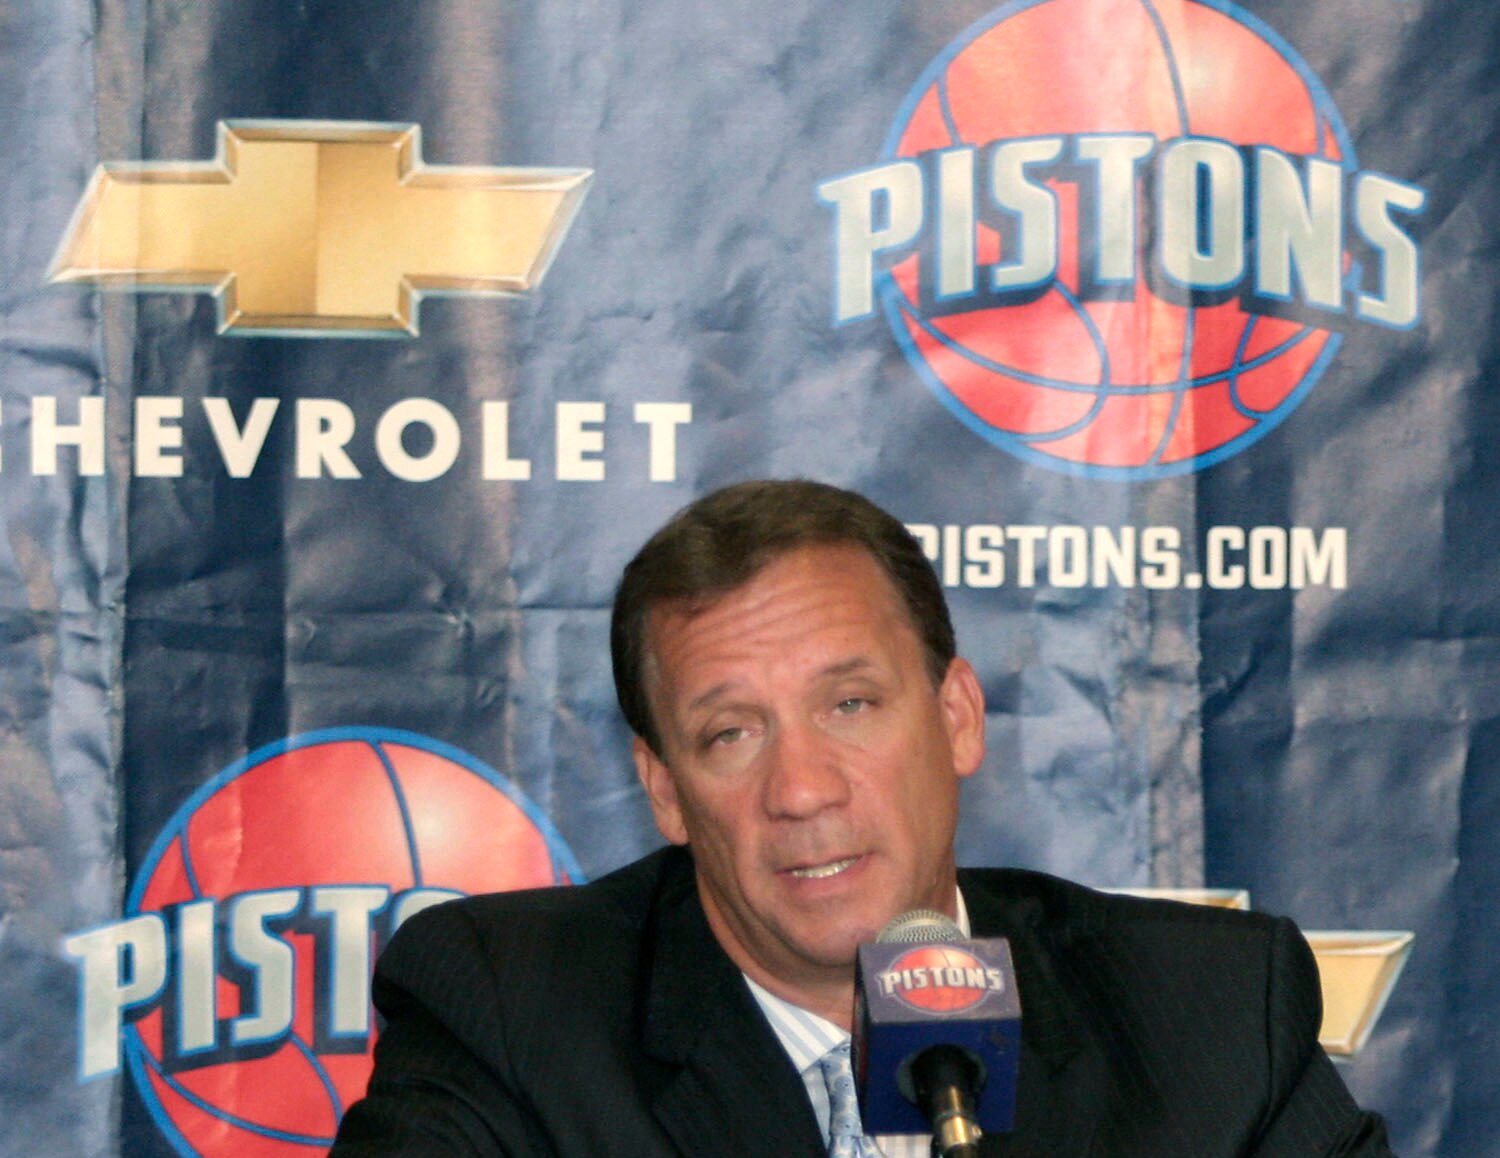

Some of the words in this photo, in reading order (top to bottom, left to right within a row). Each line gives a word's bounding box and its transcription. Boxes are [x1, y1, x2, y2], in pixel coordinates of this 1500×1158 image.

[816, 134, 1428, 328] PISTONS
[0, 395, 693, 482] HEVROLET
[65, 884, 470, 1081] PIST
[878, 966, 1004, 996] PISTONS
